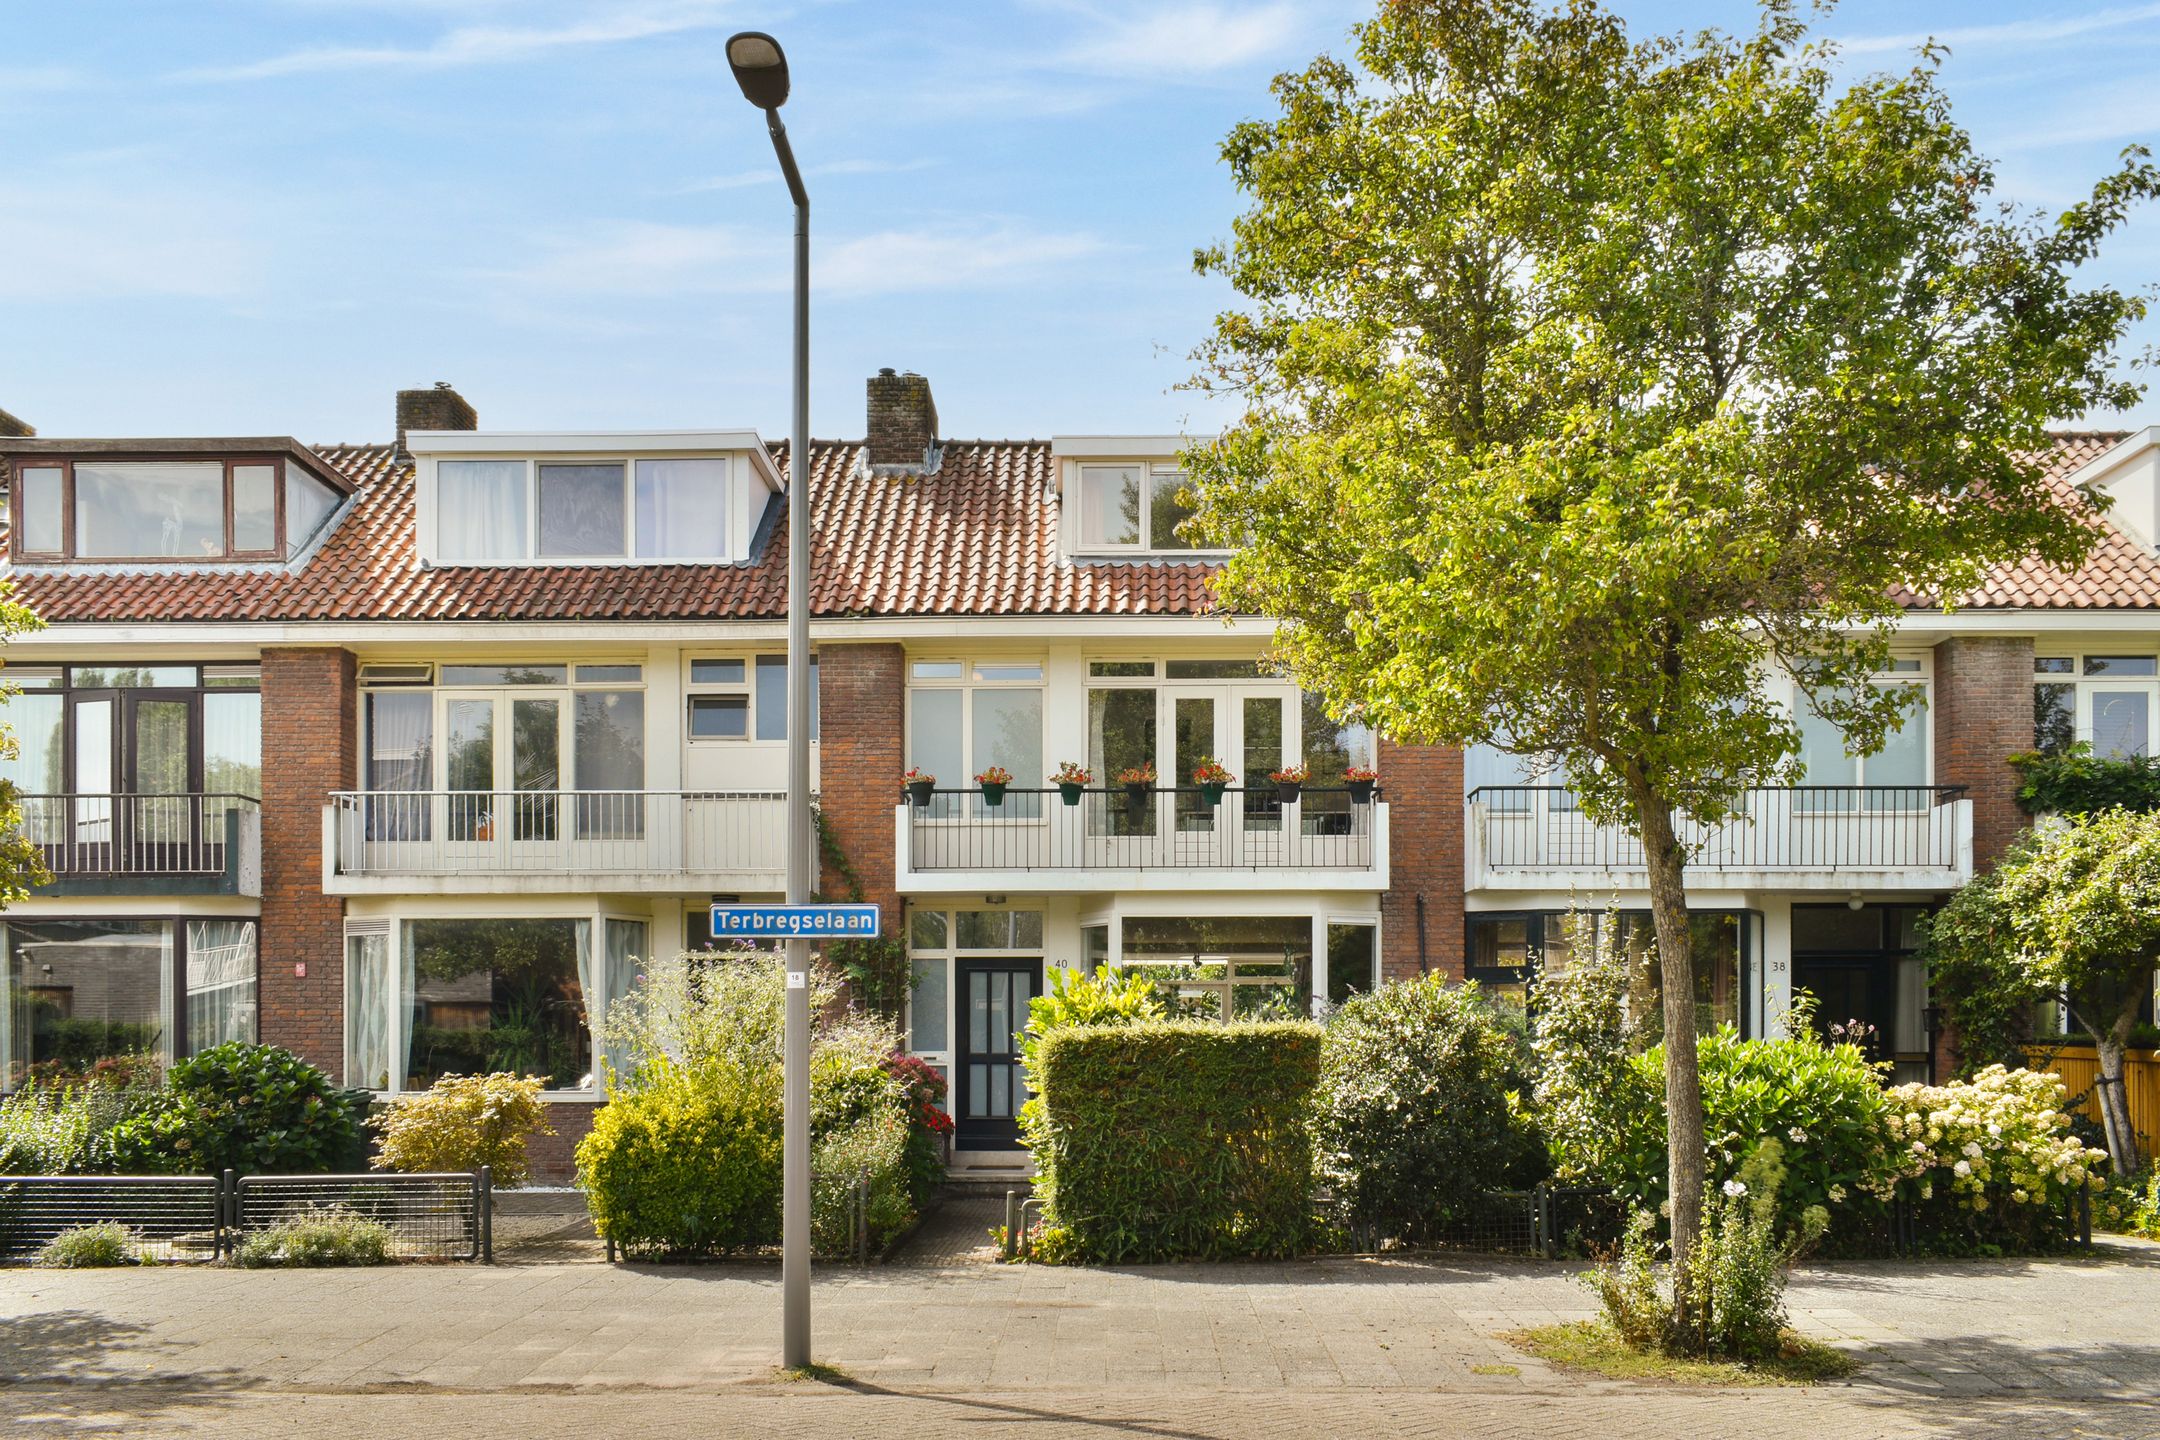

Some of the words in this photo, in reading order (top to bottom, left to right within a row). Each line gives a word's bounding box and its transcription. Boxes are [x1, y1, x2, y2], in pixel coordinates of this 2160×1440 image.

[717, 911, 872, 934] Terbregselaan
[1055, 959, 1068, 969] 40
[1772, 961, 1786, 972] 38
